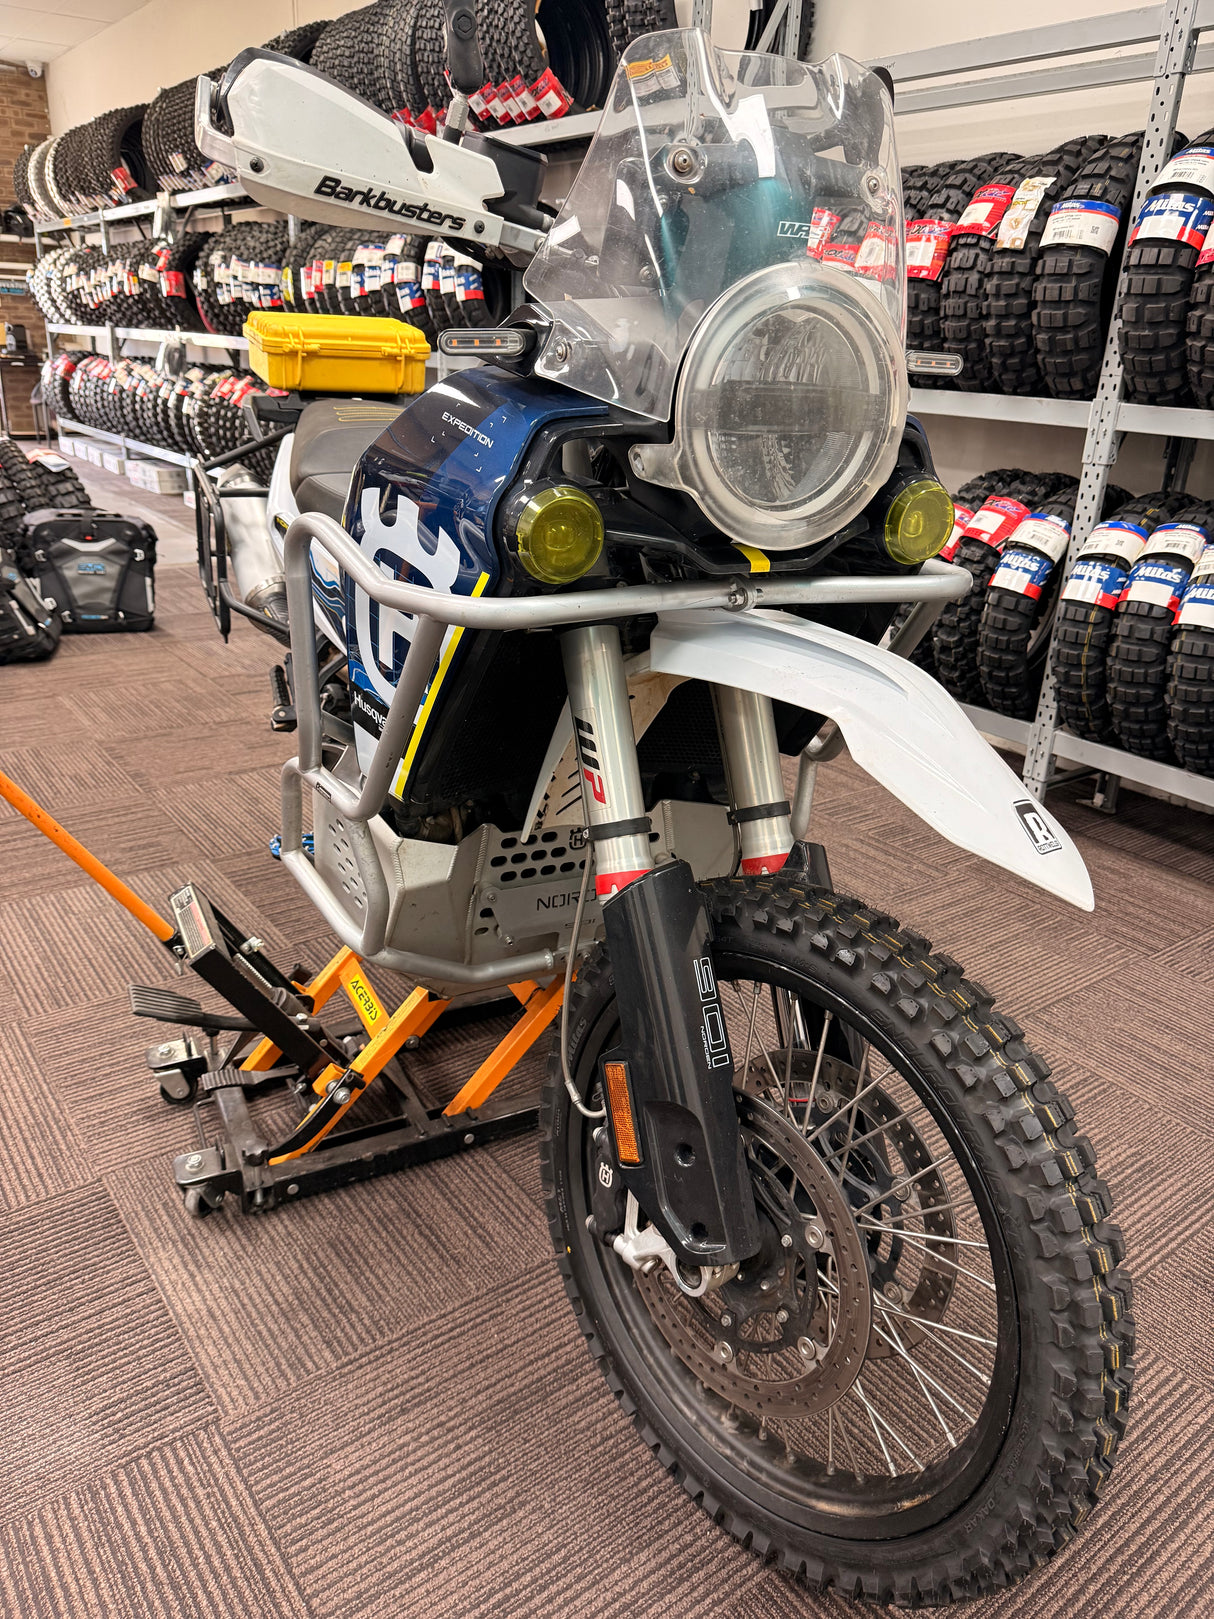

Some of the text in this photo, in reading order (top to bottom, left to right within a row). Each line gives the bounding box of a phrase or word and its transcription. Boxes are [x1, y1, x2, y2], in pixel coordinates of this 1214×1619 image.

[314, 175, 466, 230] Barkbusters
[442, 411, 494, 449] EXPEDITION
[1133, 565, 1183, 583] Mitas
[353, 690, 388, 727] Husqva
[536, 887, 597, 912] NORD
[693, 956, 730, 1069] 901
[700, 1026, 713, 1070] NORDEN
